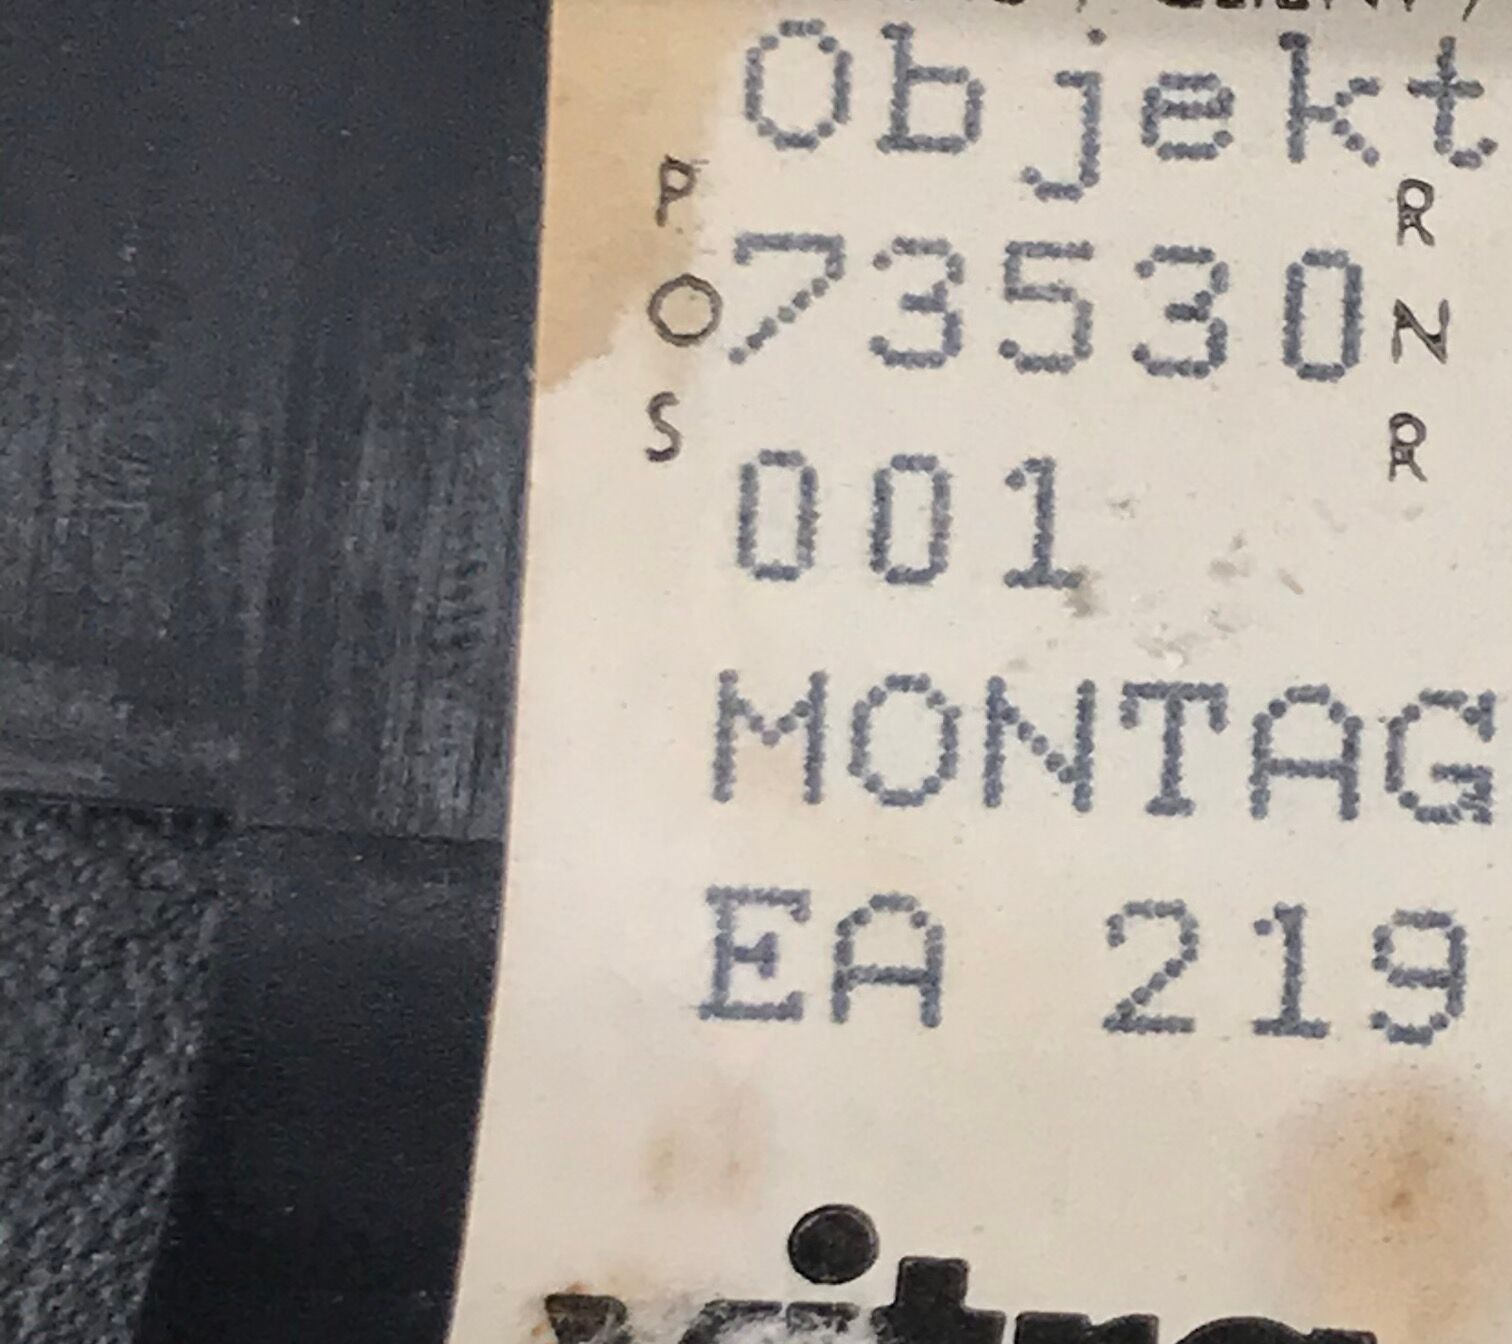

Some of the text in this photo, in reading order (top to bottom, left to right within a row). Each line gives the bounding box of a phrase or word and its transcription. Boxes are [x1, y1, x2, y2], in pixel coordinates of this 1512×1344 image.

[728, 232, 1364, 382] 73530
[736, 449, 1082, 589] 001
[697, 885, 945, 1029] EA
[1102, 898, 1468, 1047] 219
